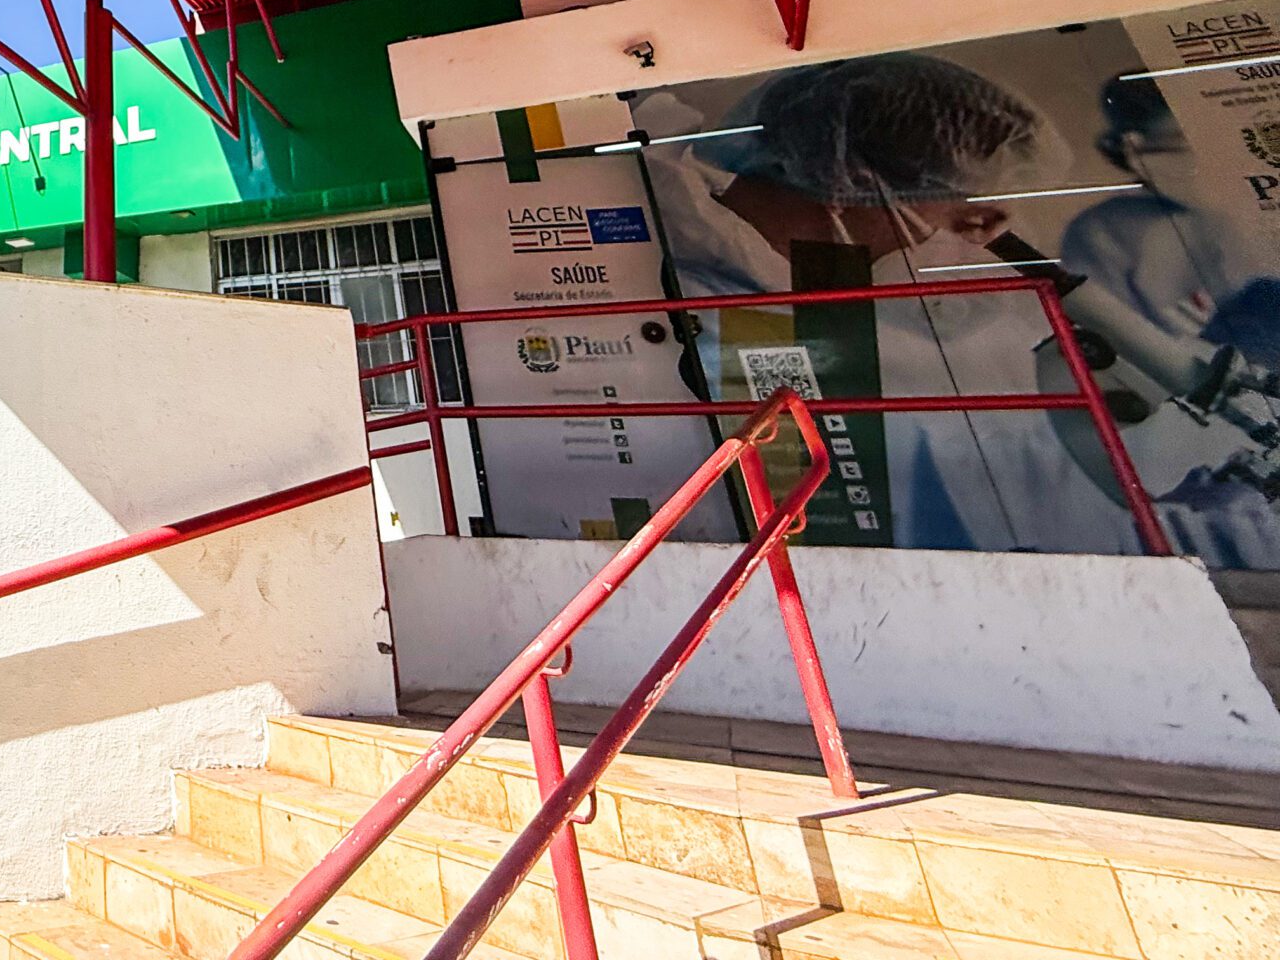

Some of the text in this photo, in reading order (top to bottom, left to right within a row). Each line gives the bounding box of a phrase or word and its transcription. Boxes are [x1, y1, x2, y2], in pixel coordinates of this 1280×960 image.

[1166, 11, 1264, 37] LACEN
[1212, 37, 1243, 52] PI
[508, 205, 584, 224] LACEN
[539, 229, 563, 247] PI
[551, 262, 609, 284] SAÚDE
[564, 334, 633, 356] Piauí
